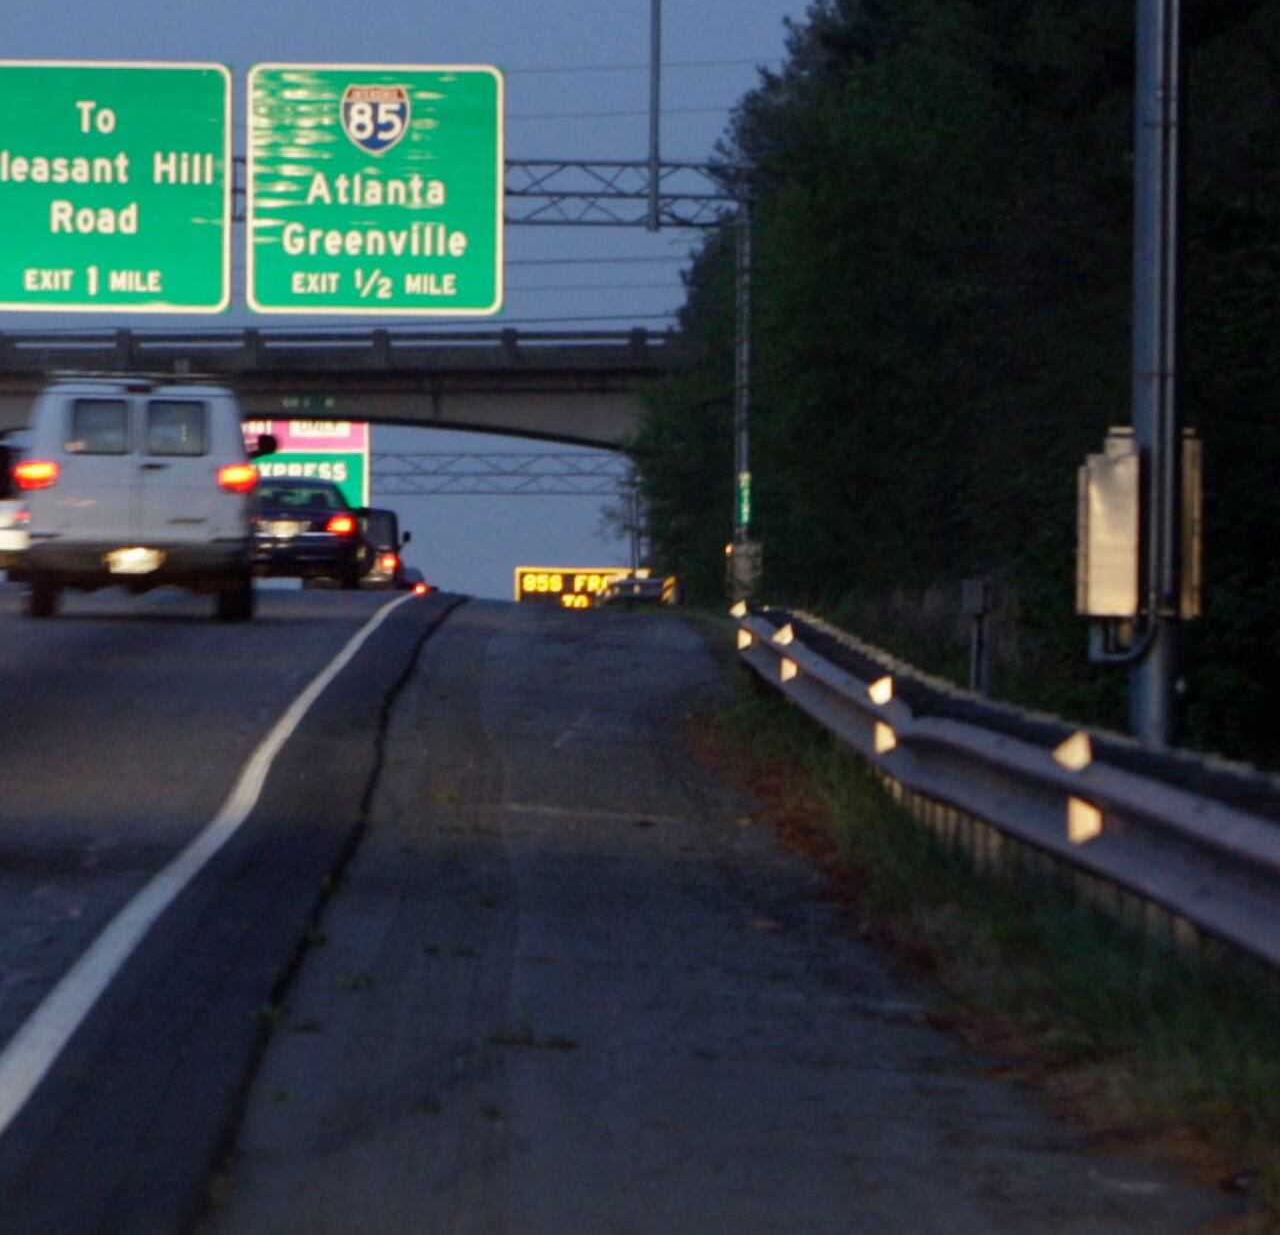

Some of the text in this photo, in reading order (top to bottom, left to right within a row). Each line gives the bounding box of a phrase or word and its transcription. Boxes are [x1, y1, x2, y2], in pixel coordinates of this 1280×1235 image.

[76, 100, 116, 134] To
[349, 102, 402, 140] 85
[153, 151, 215, 185] Hill
[306, 172, 446, 207] Atlanta
[50, 200, 139, 235] Road
[281, 223, 468, 257] Greenville
[23, 265, 162, 296] EXIT 1 MILE
[291, 271, 340, 294] EXIT
[404, 273, 457, 296] MILE
[256, 461, 348, 482] XPRESS
